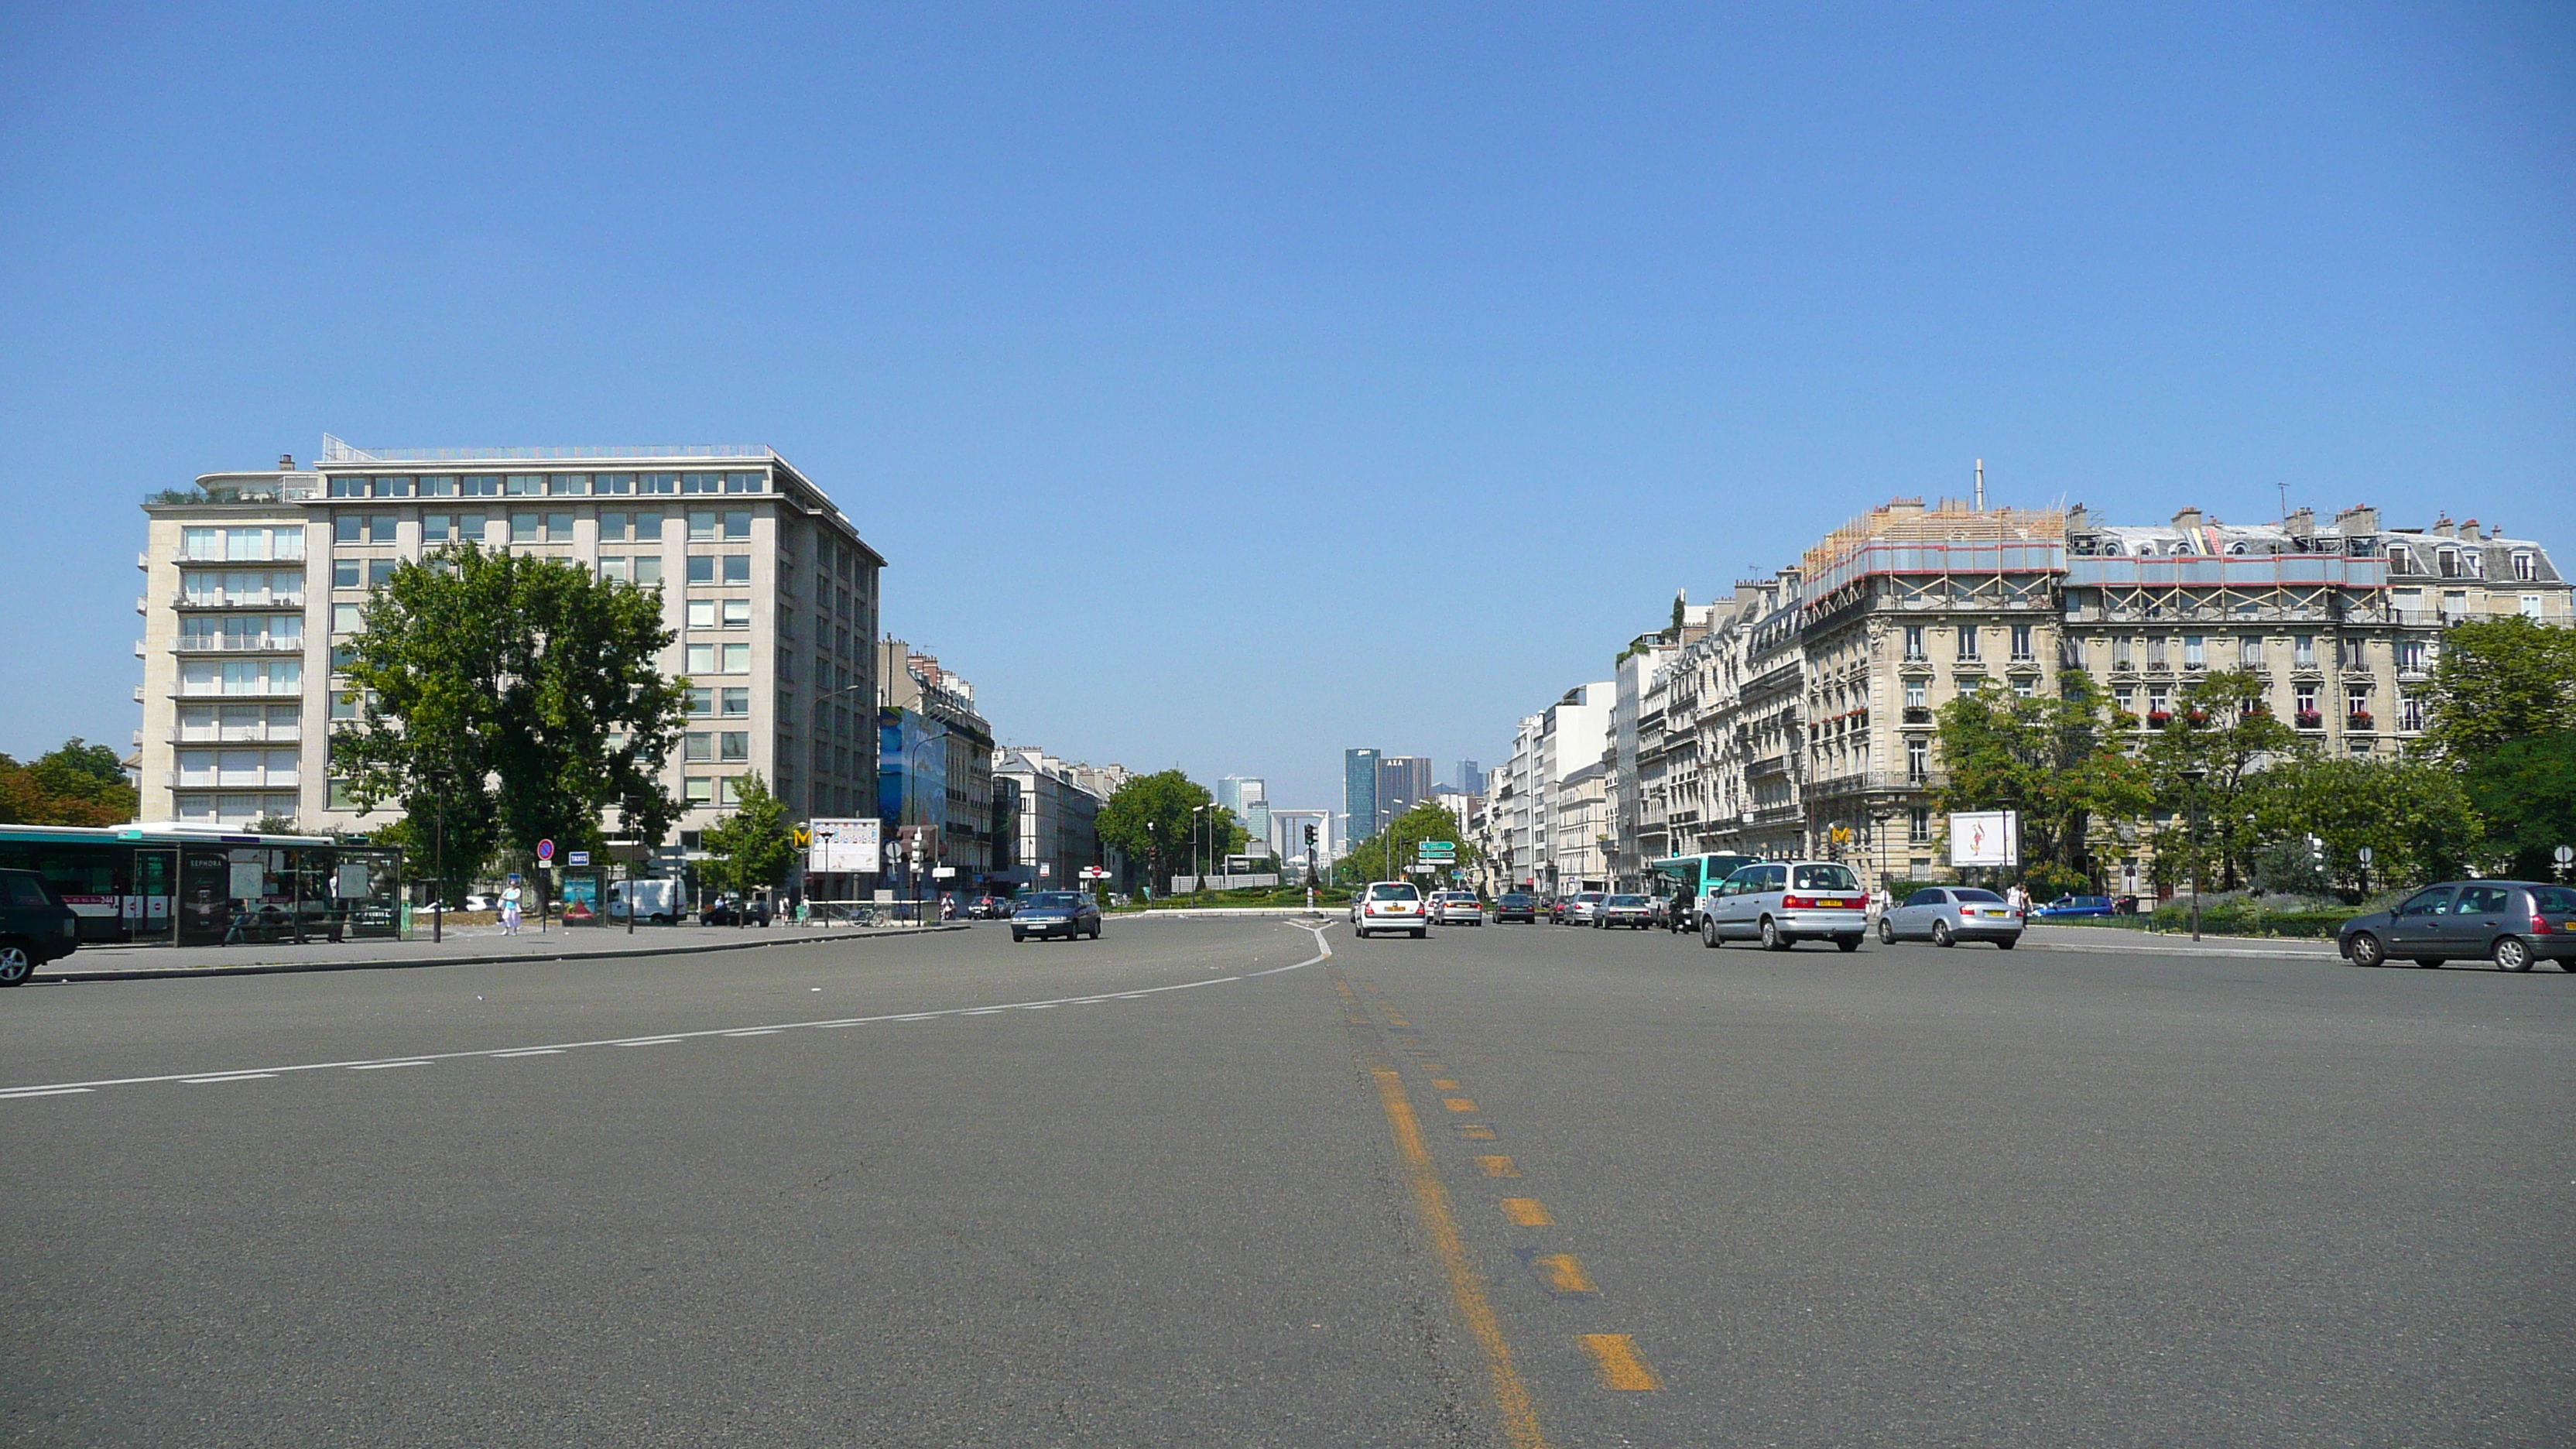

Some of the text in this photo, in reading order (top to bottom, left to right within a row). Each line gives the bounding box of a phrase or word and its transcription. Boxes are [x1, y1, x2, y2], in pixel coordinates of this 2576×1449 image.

[793, 830, 812, 847] M
[1832, 827, 1849, 844] M
[101, 896, 113, 904] 244
